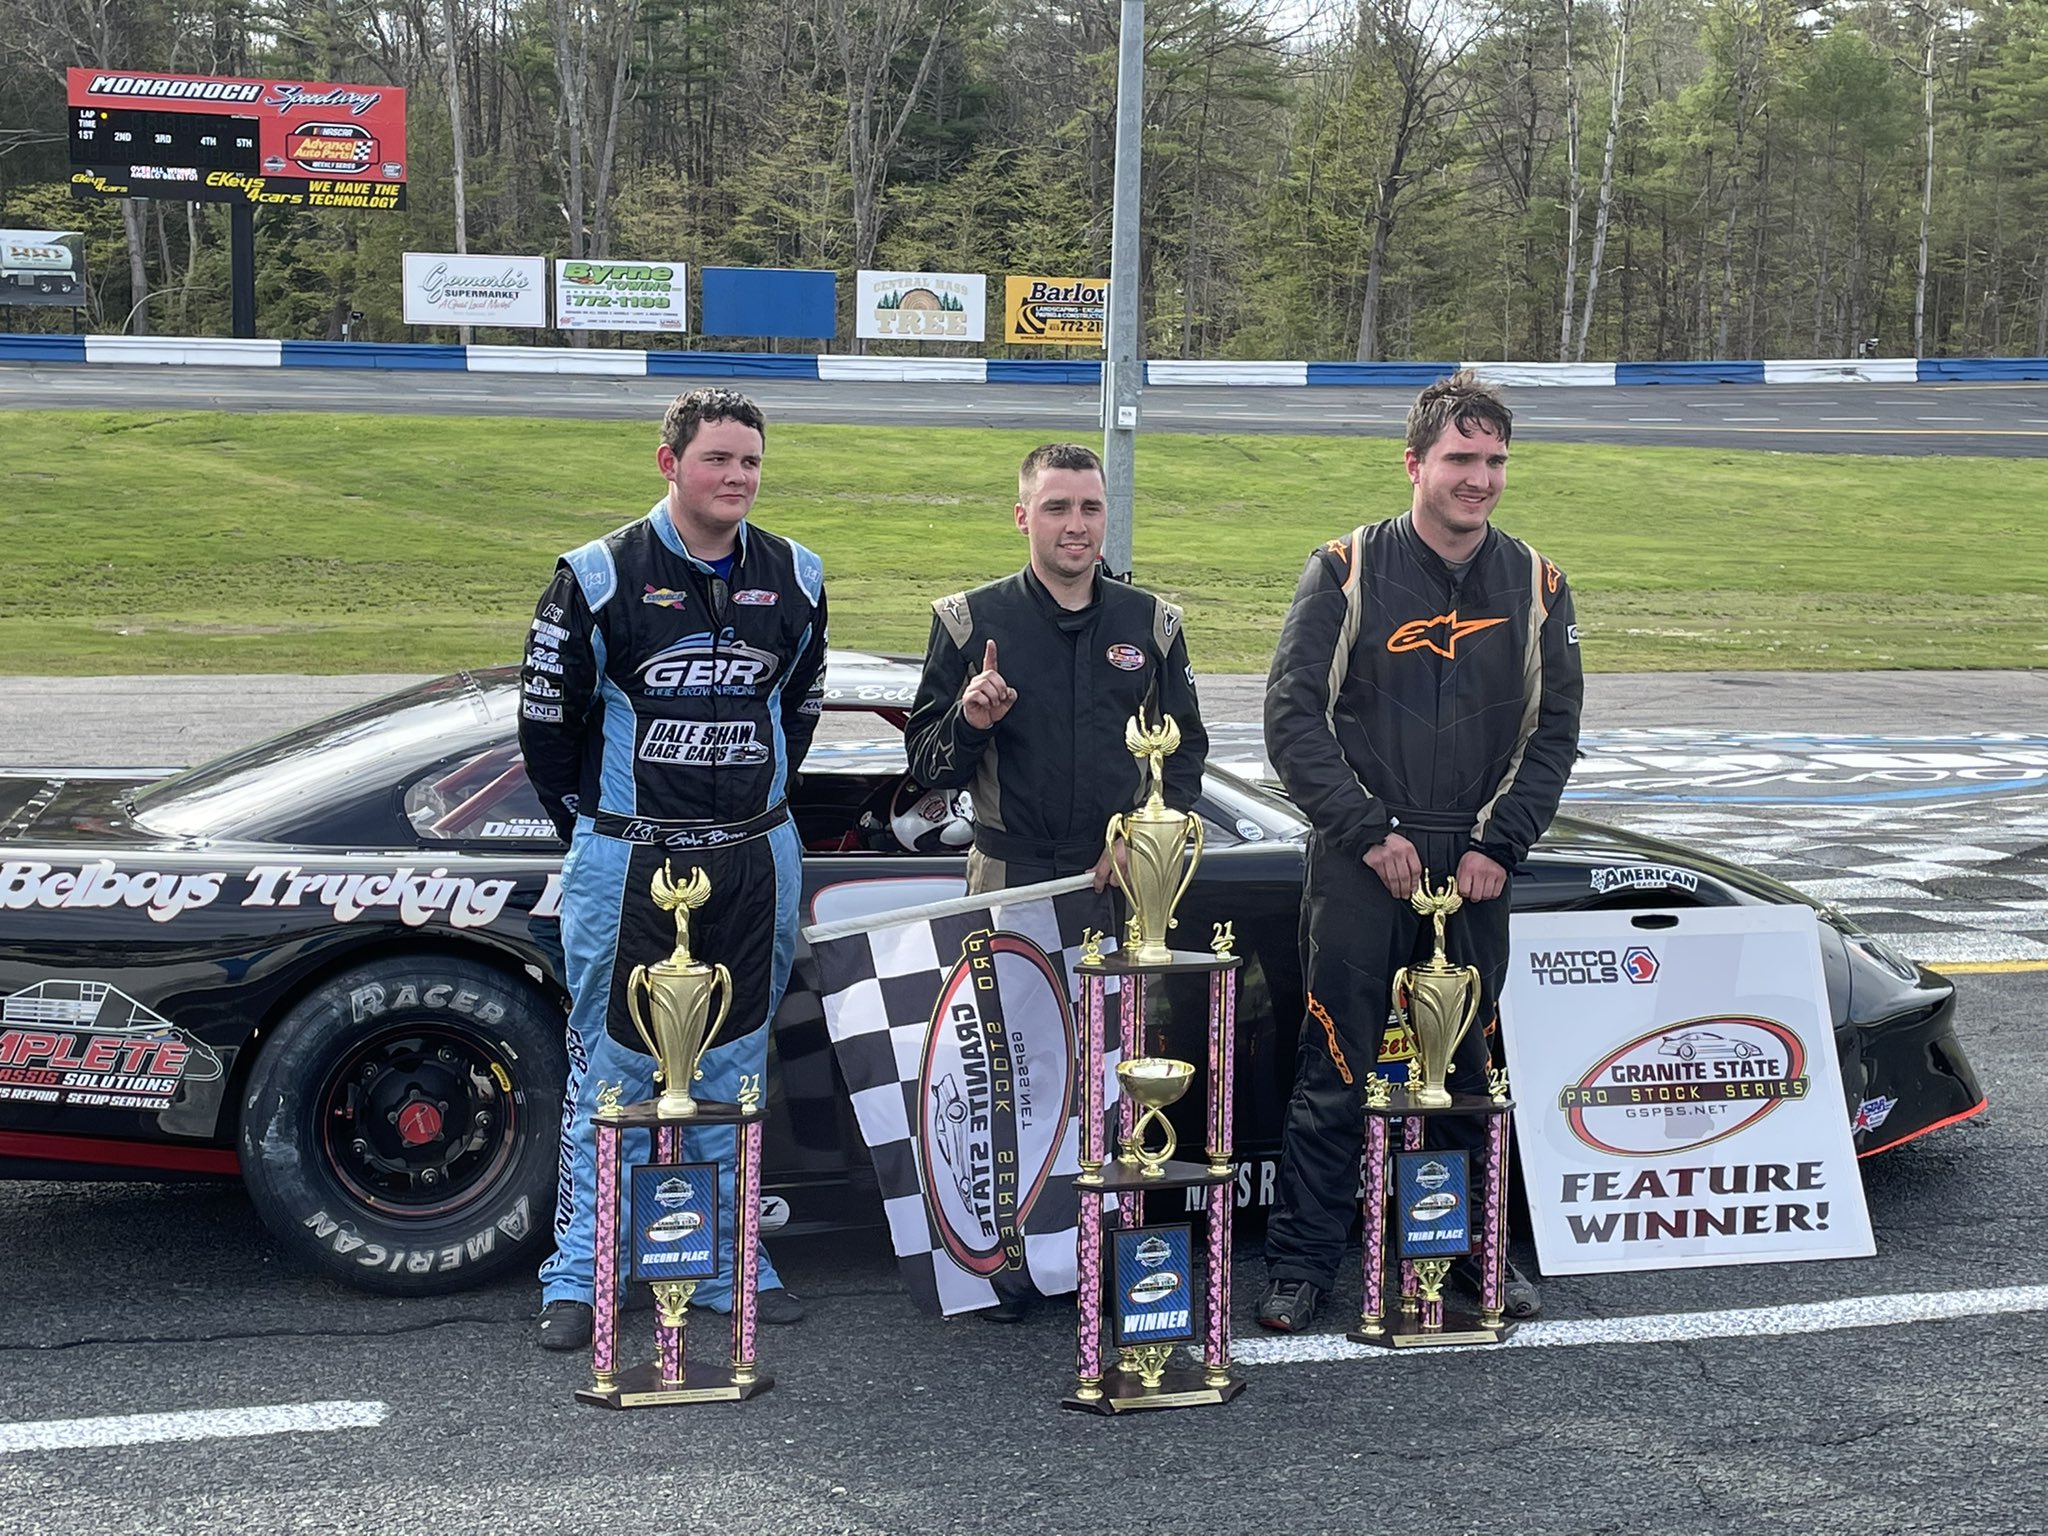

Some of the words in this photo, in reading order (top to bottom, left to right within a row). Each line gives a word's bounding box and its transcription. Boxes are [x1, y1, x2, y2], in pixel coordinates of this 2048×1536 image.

[89, 76, 261, 101] MONADNOCK
[265, 86, 381, 115] Speedway
[78, 119, 96, 128] TIME
[80, 110, 95, 118] LAP
[78, 130, 94, 140] 1ST
[114, 131, 132, 142] 2ND
[155, 134, 172, 144] 3RD
[200, 137, 217, 146] 4TH
[236, 138, 252, 147] 5TH
[322, 127, 354, 137] NASCAR
[300, 138, 352, 150] Advance
[294, 149, 321, 158] Auto
[322, 150, 350, 159] Parts
[335, 161, 356, 169] SERIES
[206, 171, 265, 191] EKeys
[309, 180, 333, 192] WE
[334, 181, 371, 194] HAVE
[374, 184, 400, 196] THE
[246, 188, 303, 204] 4cars
[308, 194, 398, 209] TECHNOLOGY
[563, 262, 674, 285] Byrne
[445, 289, 520, 299] SUPERMARKET
[605, 280, 672, 292] TOWING
[873, 277, 930, 293] CENTRAL
[935, 279, 969, 296] MASS
[874, 309, 968, 336] TREE
[644, 659, 764, 688] GBR
[649, 722, 700, 744] DALE
[700, 725, 754, 746] SHAW
[643, 742, 684, 760] RACE
[684, 745, 729, 762] CARS
[1600, 867, 1697, 893] AMERICAN
[241, 865, 518, 928] Trucking
[1530, 950, 1616, 969] MATCO
[1532, 967, 1618, 985] TOOLS
[350, 981, 505, 1025] RACER
[1611, 1063, 1707, 1083] GRANITE
[1714, 1059, 1780, 1078] STATE
[62, 1072, 177, 1092] SOLUTIONS
[11, 1088, 59, 1102] REPAIR
[66, 1092, 109, 1106] SETUP
[109, 1096, 170, 1110] SERVICES
[1566, 1089, 1607, 1105] PRO
[1630, 1085, 1701, 1102] STOCK
[1725, 1082, 1804, 1097] SERIES
[1625, 1105, 1728, 1118] GSPSS.NET
[1560, 1160, 1827, 1203] FEATURE
[1566, 1201, 1831, 1244] WINNER!
[303, 1194, 532, 1274] AMERICAN
[1407, 1230, 1435, 1242] THIRD
[1436, 1228, 1464, 1240] PLACE
[642, 1252, 680, 1265] SECOND
[680, 1250, 710, 1262] PLACE
[1123, 1309, 1189, 1333] WINNER
